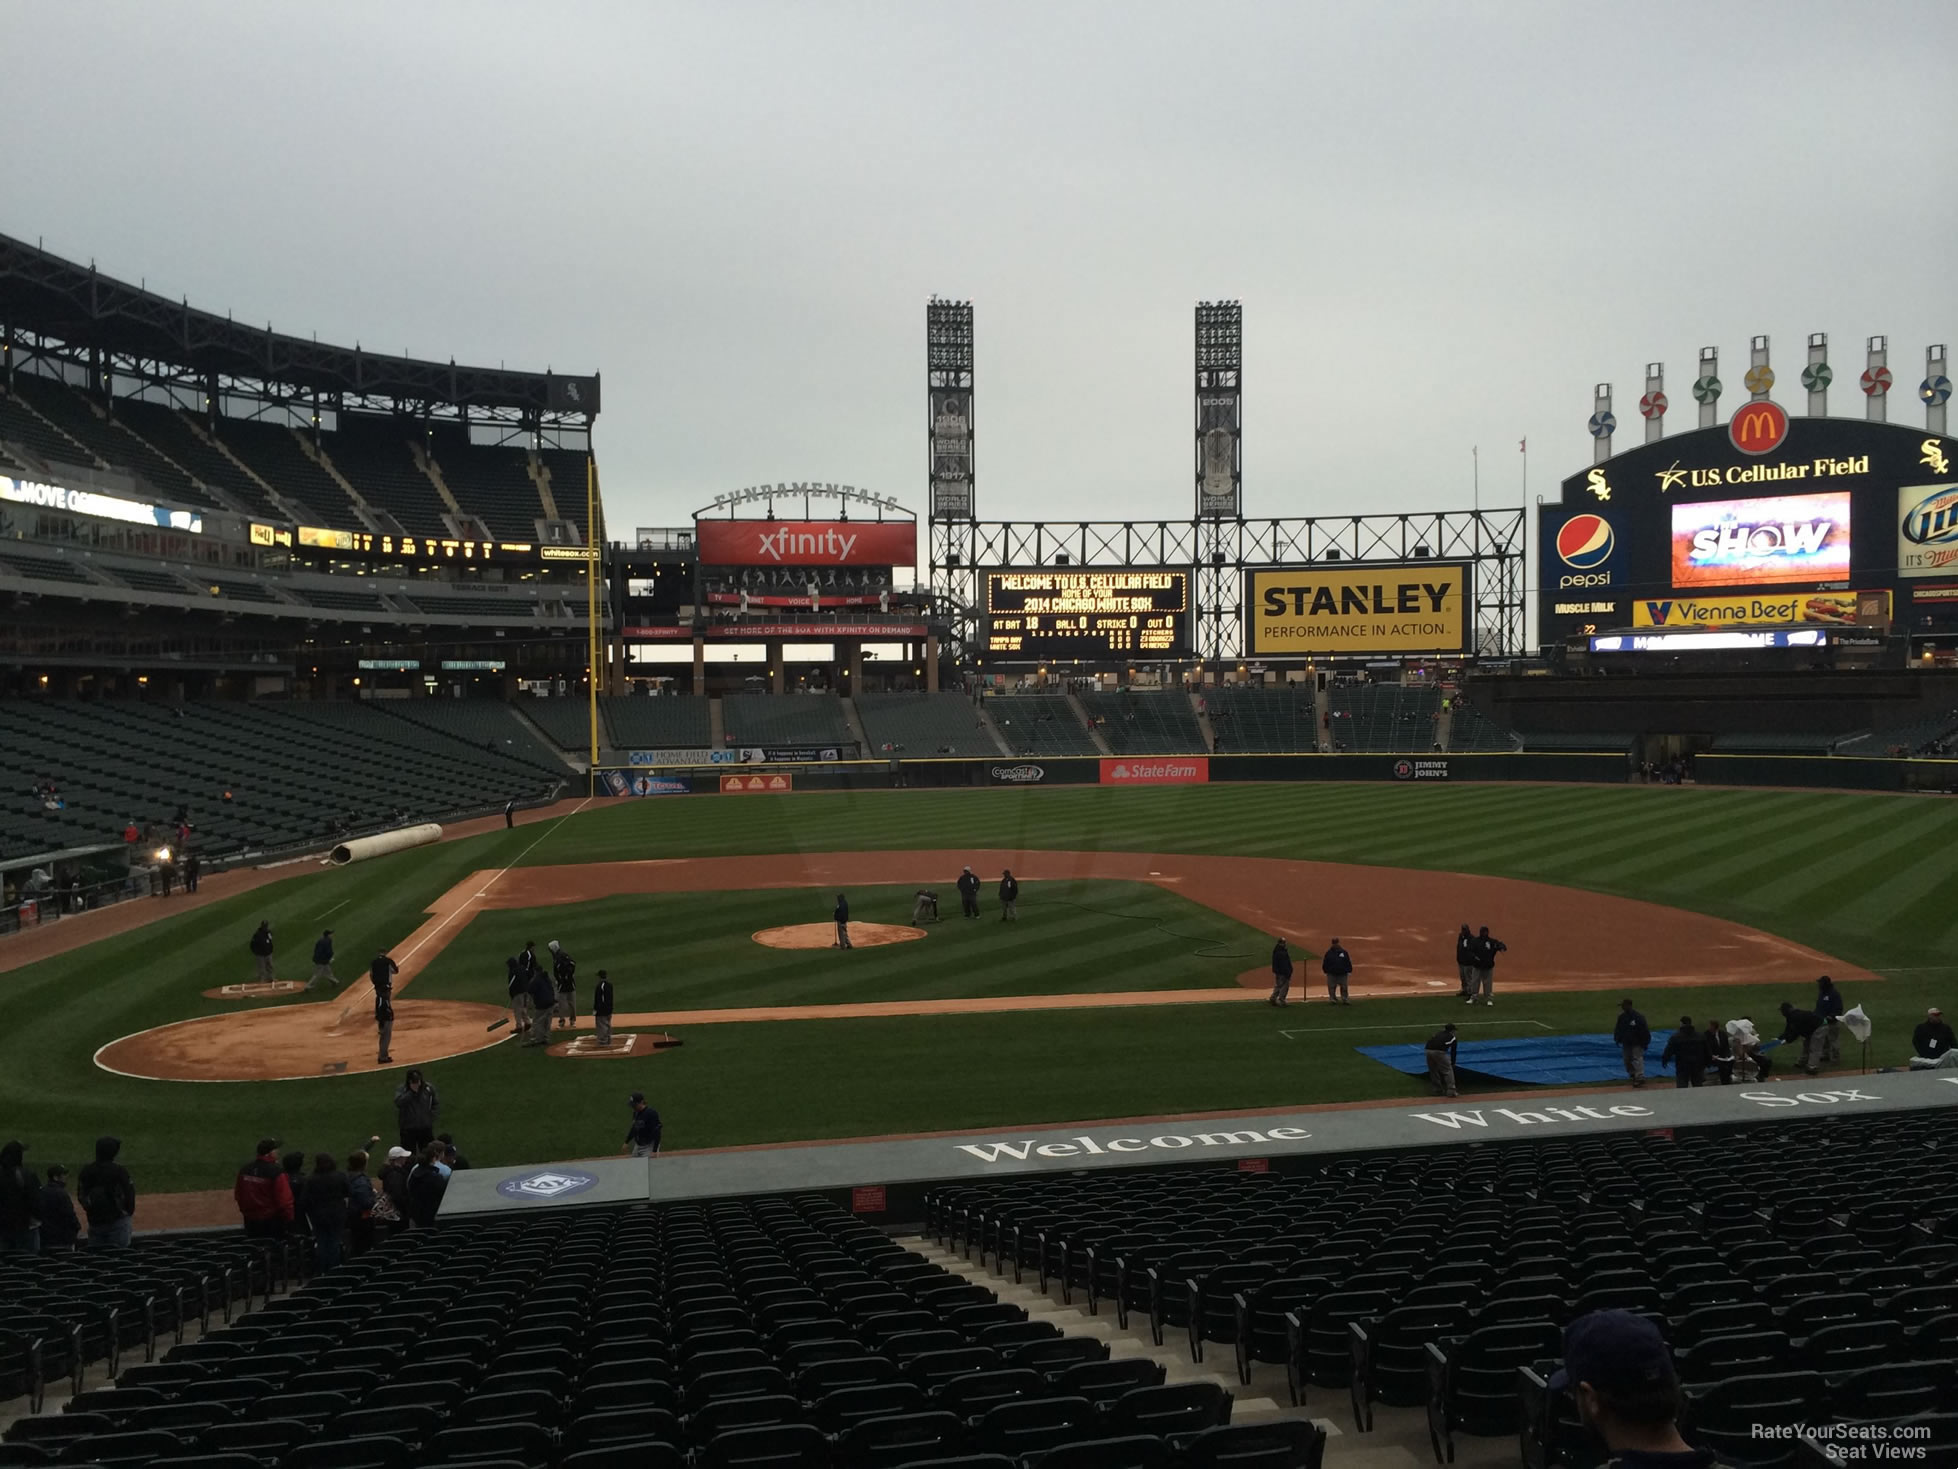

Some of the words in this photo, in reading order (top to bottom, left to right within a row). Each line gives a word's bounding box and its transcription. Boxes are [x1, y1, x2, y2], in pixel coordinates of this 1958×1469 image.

[939, 471, 966, 480] 1917
[1692, 470, 1723, 487] U.S.
[1726, 459, 1810, 484] Cellular
[1813, 456, 1869, 477] Field
[714, 482, 897, 512] FUNDAMENTALS
[758, 527, 857, 561] xfinity
[1689, 522, 1832, 560] SHOW
[1905, 554, 1923, 567] IT'S
[1002, 576, 1053, 591] WELCOME
[1055, 576, 1069, 590] TO
[1070, 576, 1089, 589] U.S.
[1090, 576, 1142, 590] CELLULAR
[1143, 576, 1172, 589] FIELD
[1559, 570, 1611, 589] pepsi
[1061, 589, 1082, 598] HOME
[1083, 589, 1093, 598] OF
[1093, 589, 1113, 598] YOUR
[1264, 583, 1452, 617] STANLEY
[1024, 598, 1051, 611] 2014
[1052, 598, 1096, 611] CHICAGO
[1096, 597, 1129, 610] WHITE
[1130, 597, 1153, 610] SOX
[1555, 603, 1590, 614] MUSCLE
[1591, 602, 1615, 613] MILK
[1678, 603, 1747, 620] Vienna
[1751, 599, 1799, 621] Beef
[993, 620, 1004, 630] AT
[1005, 619, 1021, 630] BAT
[1025, 616, 1039, 630] 18
[1055, 619, 1077, 630] BALL
[1079, 615, 1088, 629] 0
[1096, 618, 1127, 629] STRIKE
[1129, 615, 1138, 629] 0
[1147, 618, 1163, 629] OUT
[1165, 615, 1174, 628] 0
[724, 627, 739, 635] GET
[764, 626, 775, 634] OF
[777, 626, 793, 634] THE
[795, 626, 812, 634] SOX
[813, 626, 835, 634] WITH
[837, 626, 866, 634] XFINITY
[869, 626, 881, 634] ON
[1264, 625, 1366, 638] PERFORMANCE
[1372, 625, 1386, 636] IN
[1109, 635, 1115, 643] 0
[1117, 635, 1123, 643] 0
[1125, 635, 1131, 643] 0
[1109, 642, 1115, 650] 0
[1117, 642, 1123, 650] 0
[1125, 642, 1131, 650] 0
[656, 757, 707, 765] ADVANTAGE
[1414, 761, 1449, 770] JIMMY
[1414, 769, 1449, 779] JOHN'S
[953, 1126, 1313, 1163] Welcome
[1408, 1101, 1655, 1131] White
[1739, 1088, 1883, 1108] Sox
